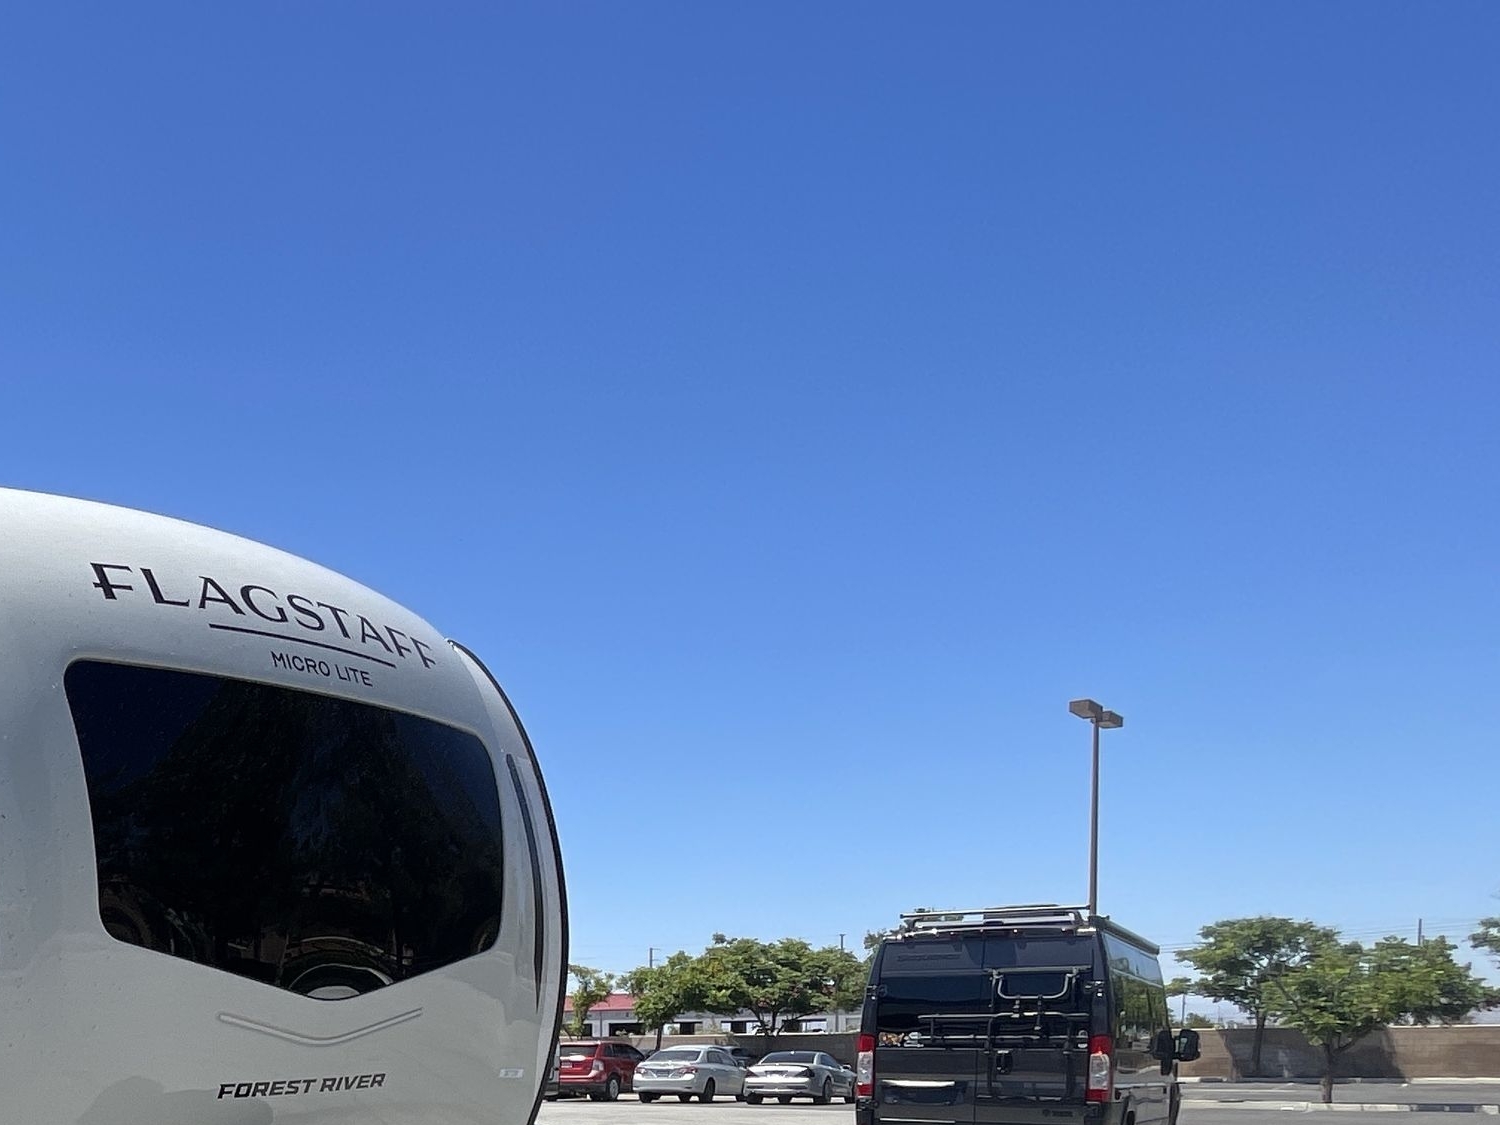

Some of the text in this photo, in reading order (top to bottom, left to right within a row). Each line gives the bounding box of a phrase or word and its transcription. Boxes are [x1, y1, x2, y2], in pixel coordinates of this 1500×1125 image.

[90, 562, 437, 669] FLAGSTAFF
[271, 651, 373, 687] MICRO LITE
[217, 1073, 386, 1099] FOREST RIVER
